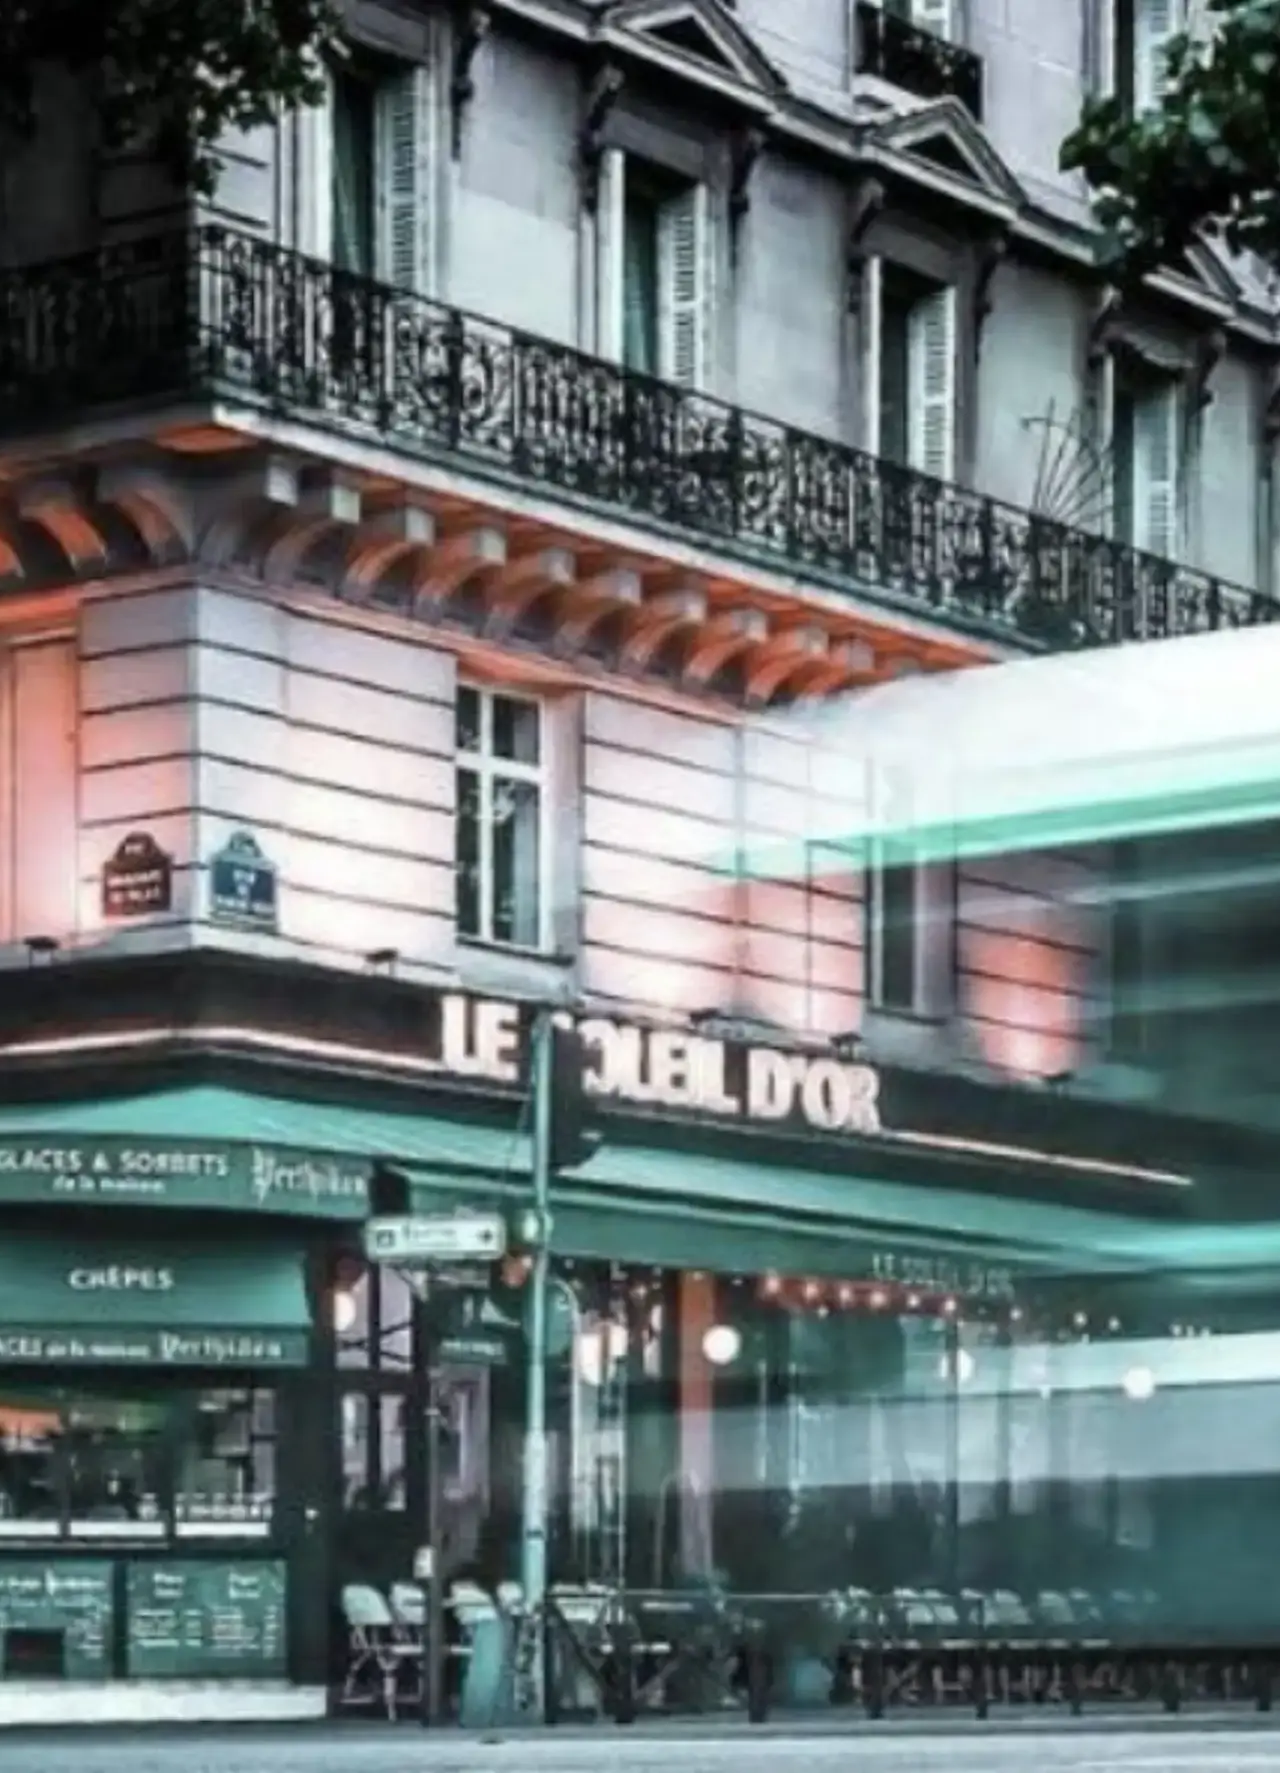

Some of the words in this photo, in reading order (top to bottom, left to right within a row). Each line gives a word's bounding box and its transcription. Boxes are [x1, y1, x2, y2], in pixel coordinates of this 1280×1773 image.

[441, 994, 520, 1081] LE
[550, 1010, 741, 1113] OLEIL
[748, 1046, 884, 1134] D'OR
[91, 1150, 111, 1174] &
[120, 1150, 230, 1177] SORBETS
[69, 1263, 175, 1291] CRÊPES
